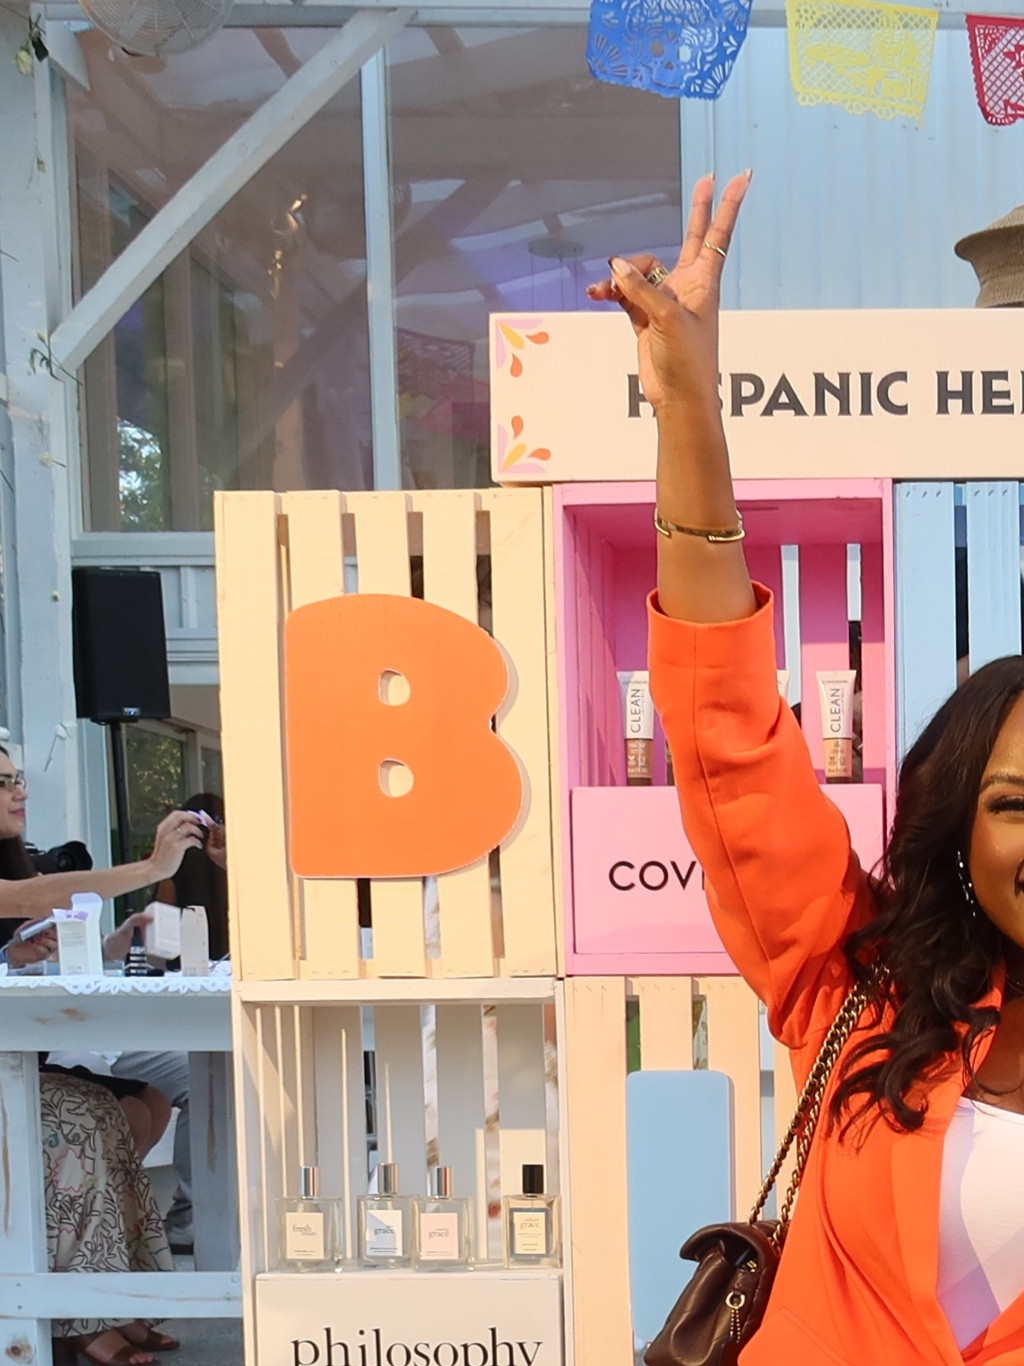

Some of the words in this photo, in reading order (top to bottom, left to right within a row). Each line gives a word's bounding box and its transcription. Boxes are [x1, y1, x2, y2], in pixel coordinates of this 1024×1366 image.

[627, 372, 908, 418] HPANIC
[630, 688, 641, 734] CLEAN
[830, 688, 841, 733] CLEAN
[608, 860, 705, 891] COV
